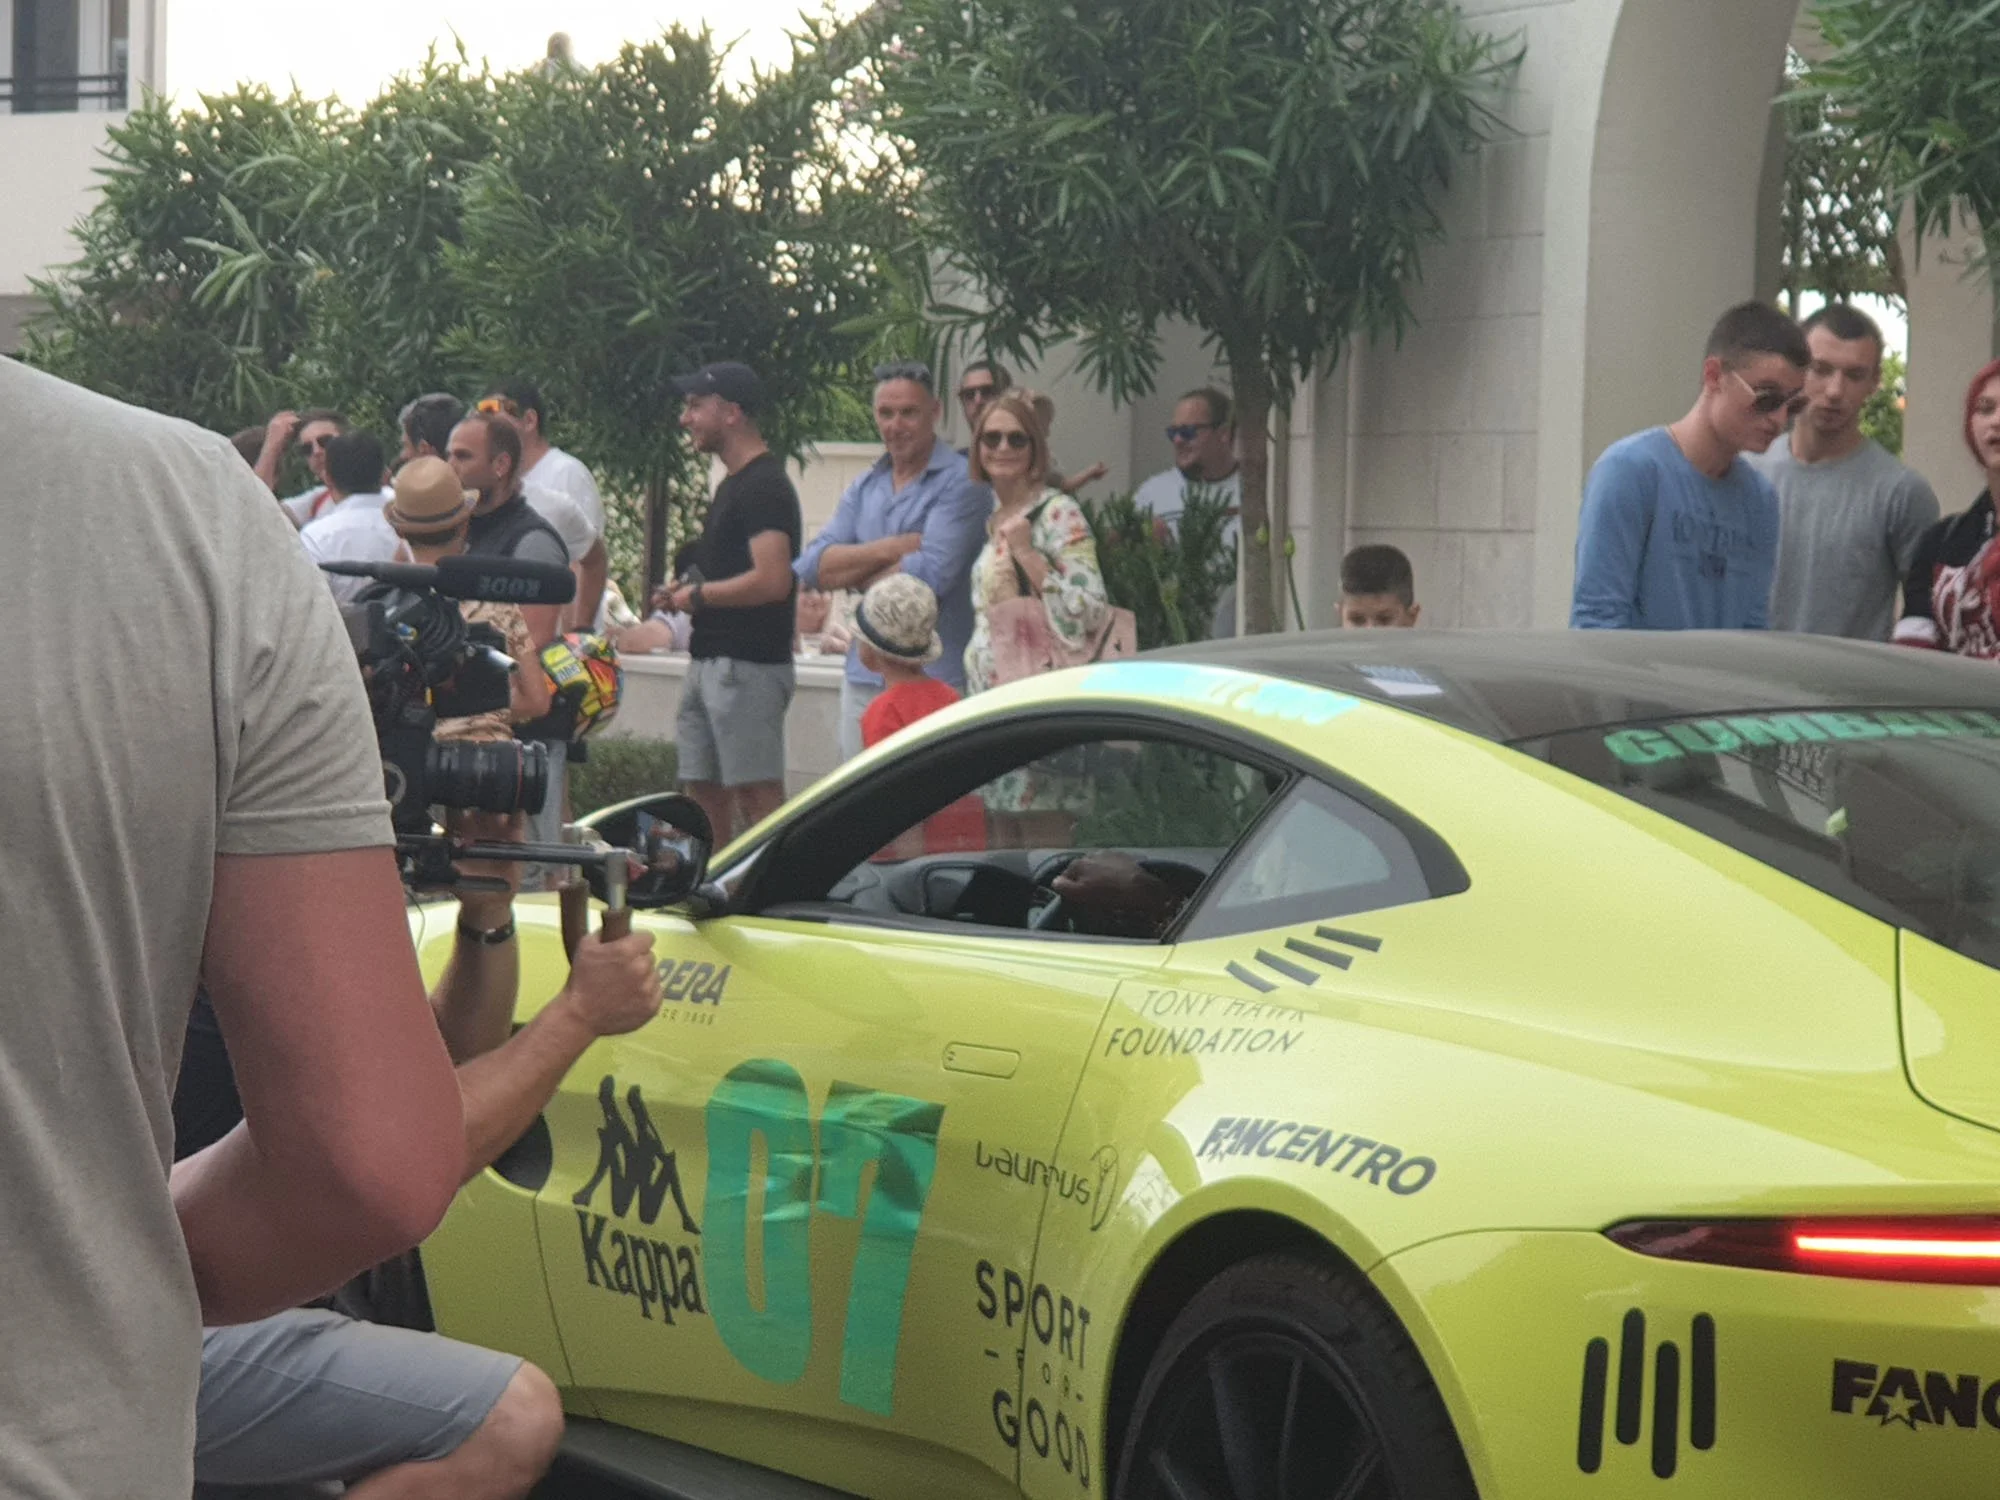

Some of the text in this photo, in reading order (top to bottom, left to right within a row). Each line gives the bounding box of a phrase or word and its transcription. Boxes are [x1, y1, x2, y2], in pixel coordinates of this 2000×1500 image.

[1104, 1026, 1305, 1058] FOUNDATION
[1140, 989, 1218, 1016] TONY
[1196, 1117, 1437, 1196] FANCENTRO
[577, 1209, 708, 1326] Kappa
[702, 1058, 947, 1418] 07
[976, 1259, 1090, 1369] SPORT
[993, 1389, 1090, 1489] GOOD
